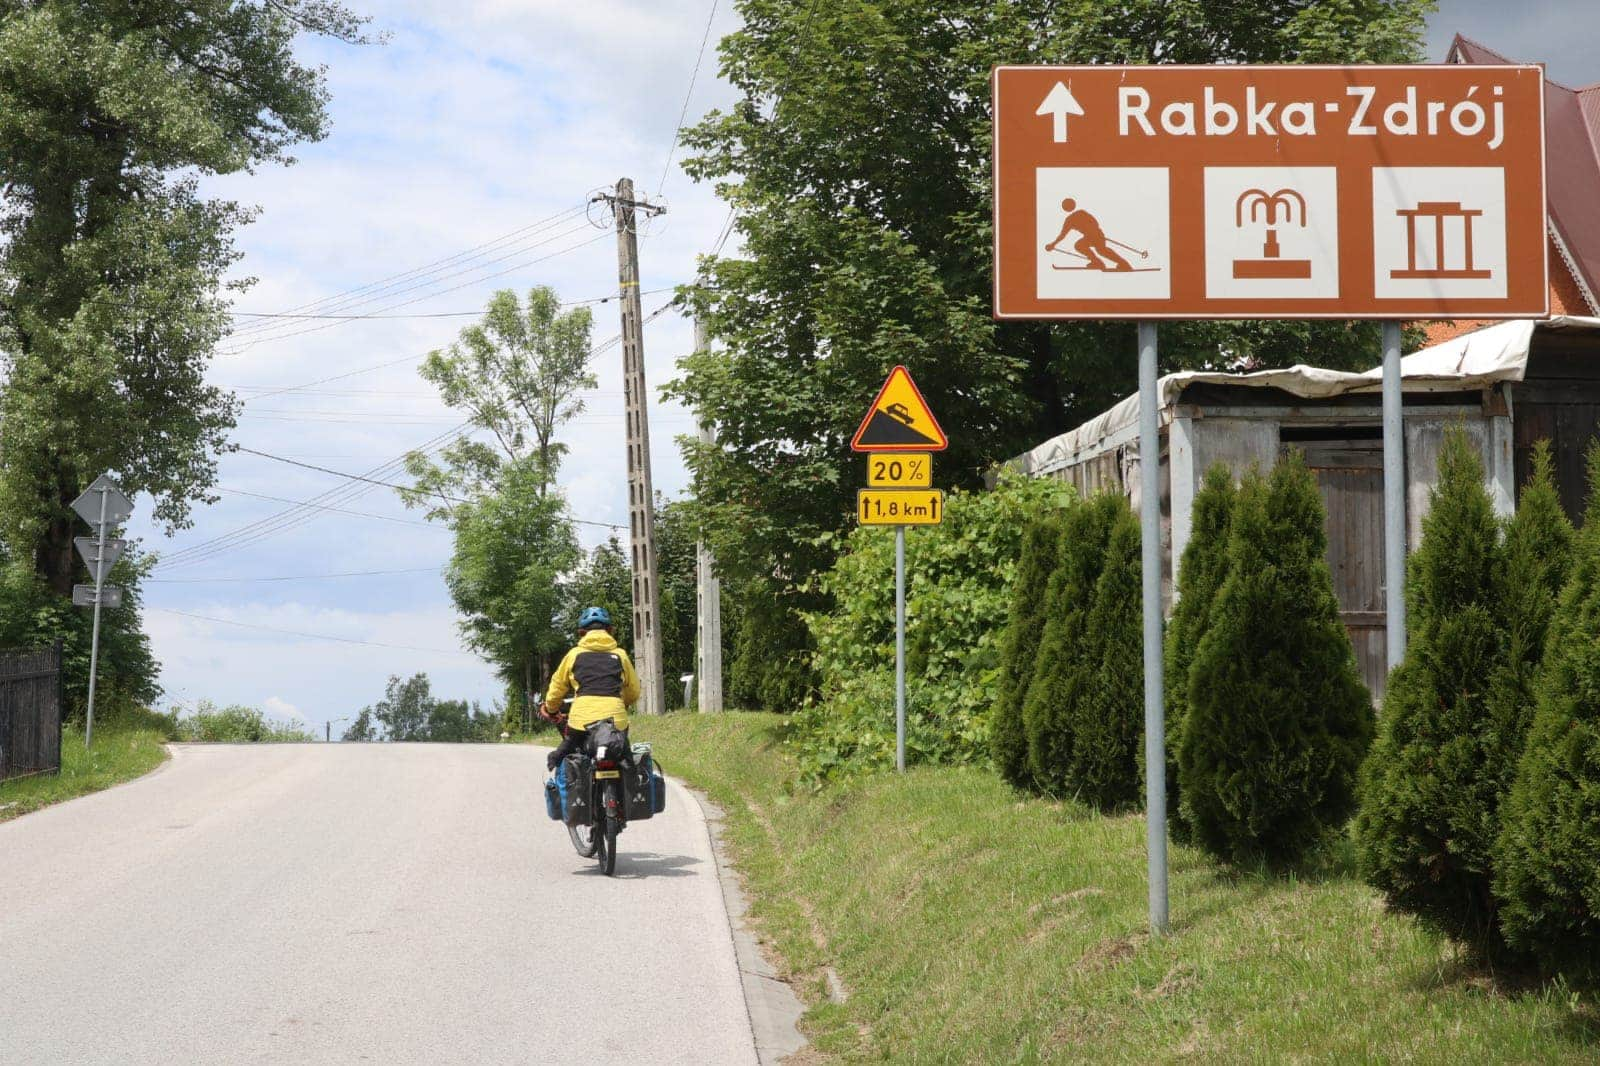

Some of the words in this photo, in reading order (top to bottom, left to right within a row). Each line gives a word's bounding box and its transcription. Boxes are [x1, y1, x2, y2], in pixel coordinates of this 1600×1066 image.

[1118, 85, 1505, 150] Rabka-Zdrój
[875, 499, 898, 516] 1,8
[903, 501, 927, 515] km
